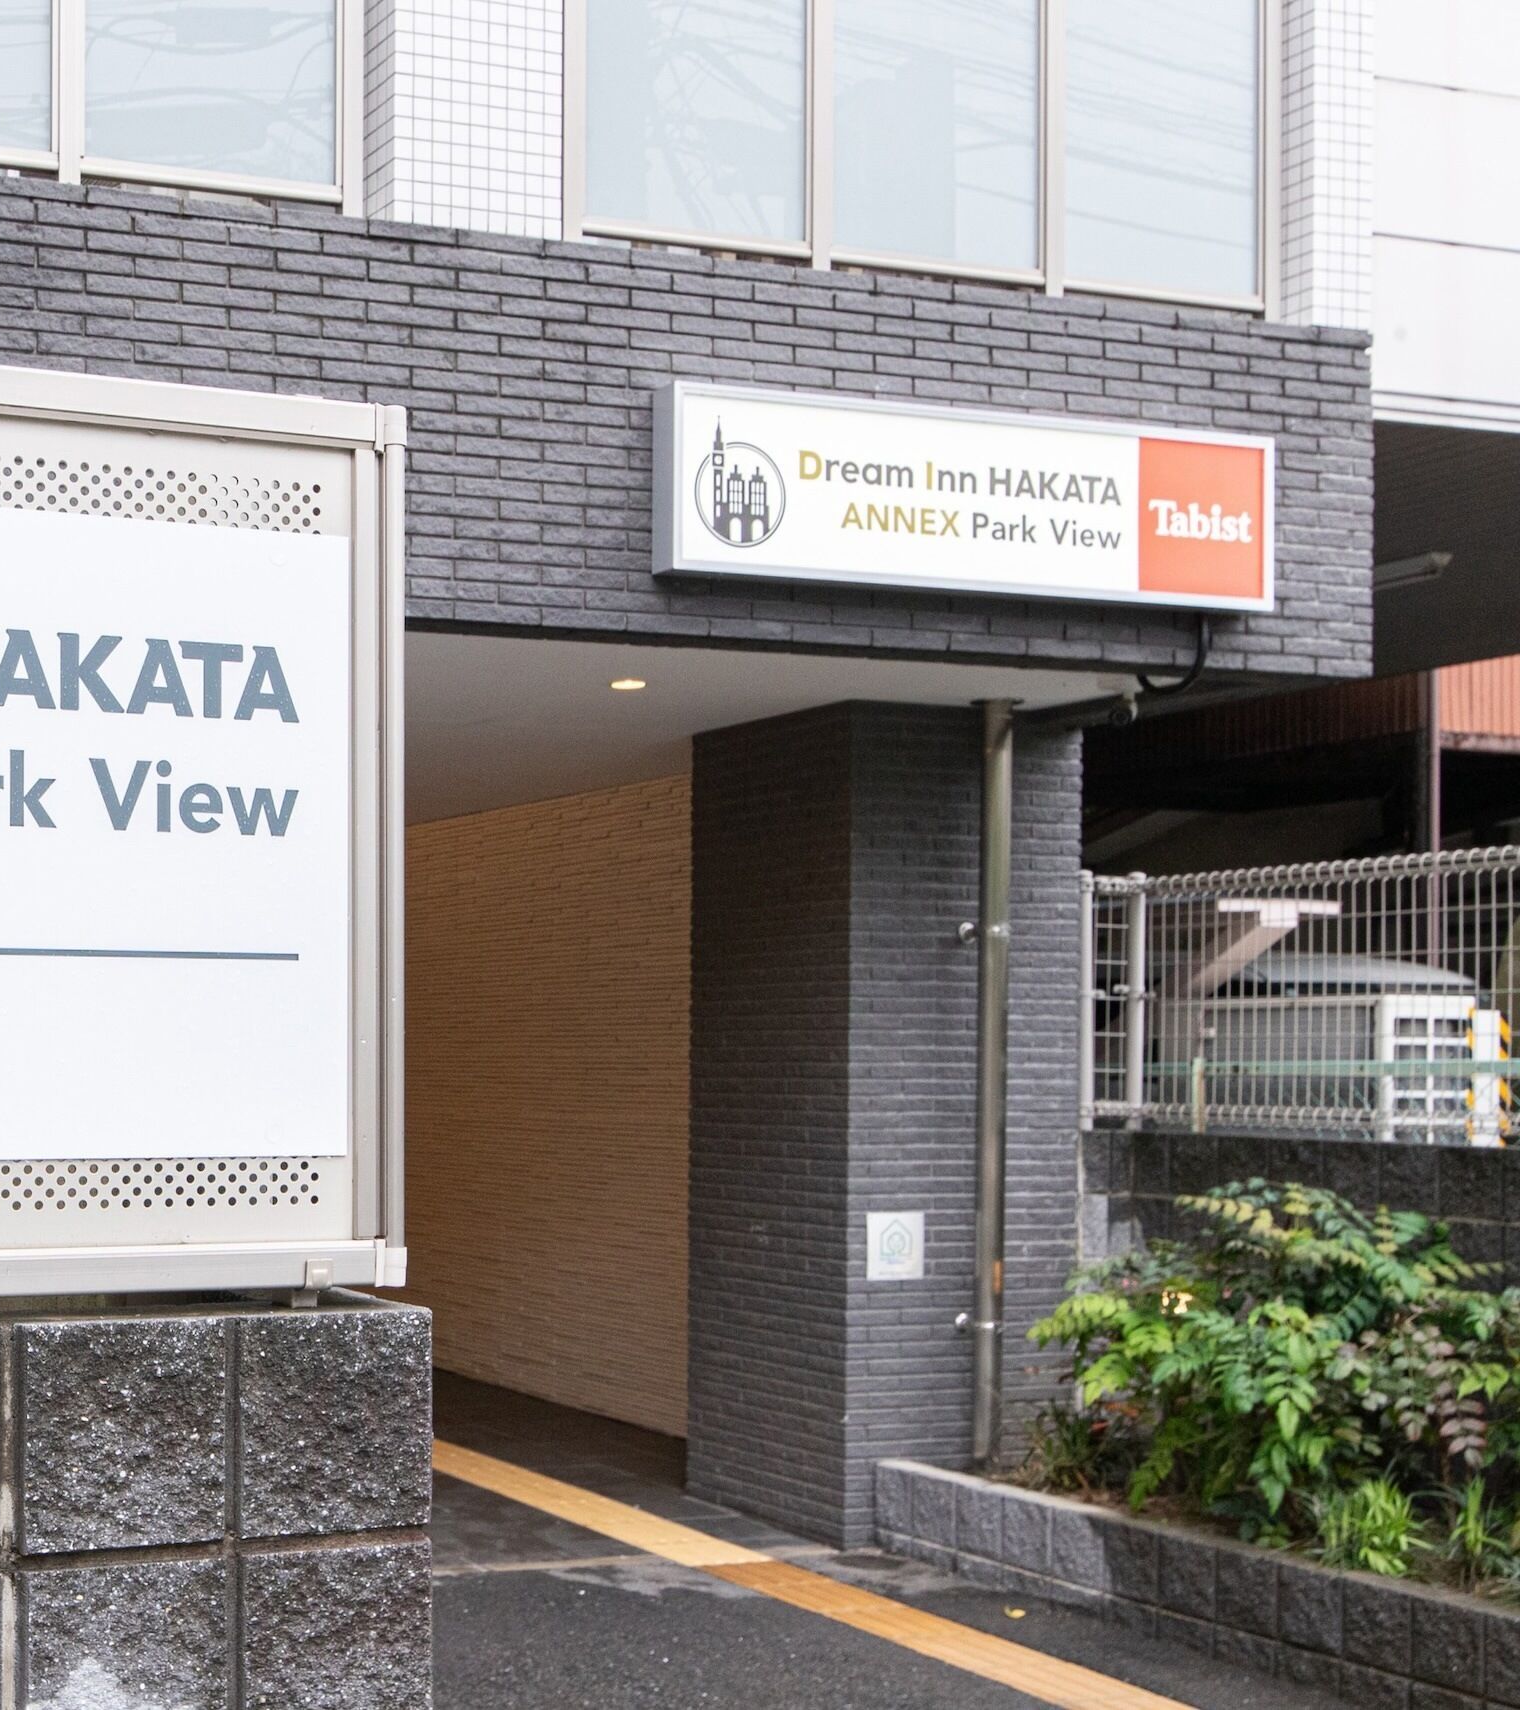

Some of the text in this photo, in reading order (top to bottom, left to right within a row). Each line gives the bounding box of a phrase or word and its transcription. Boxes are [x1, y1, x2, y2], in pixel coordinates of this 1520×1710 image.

[799, 450, 1121, 506] Dream Inn HAKATA
[841, 503, 1121, 549] ANNEX Park View
[1148, 500, 1253, 543] Tabist
[89, 758, 299, 837] View
